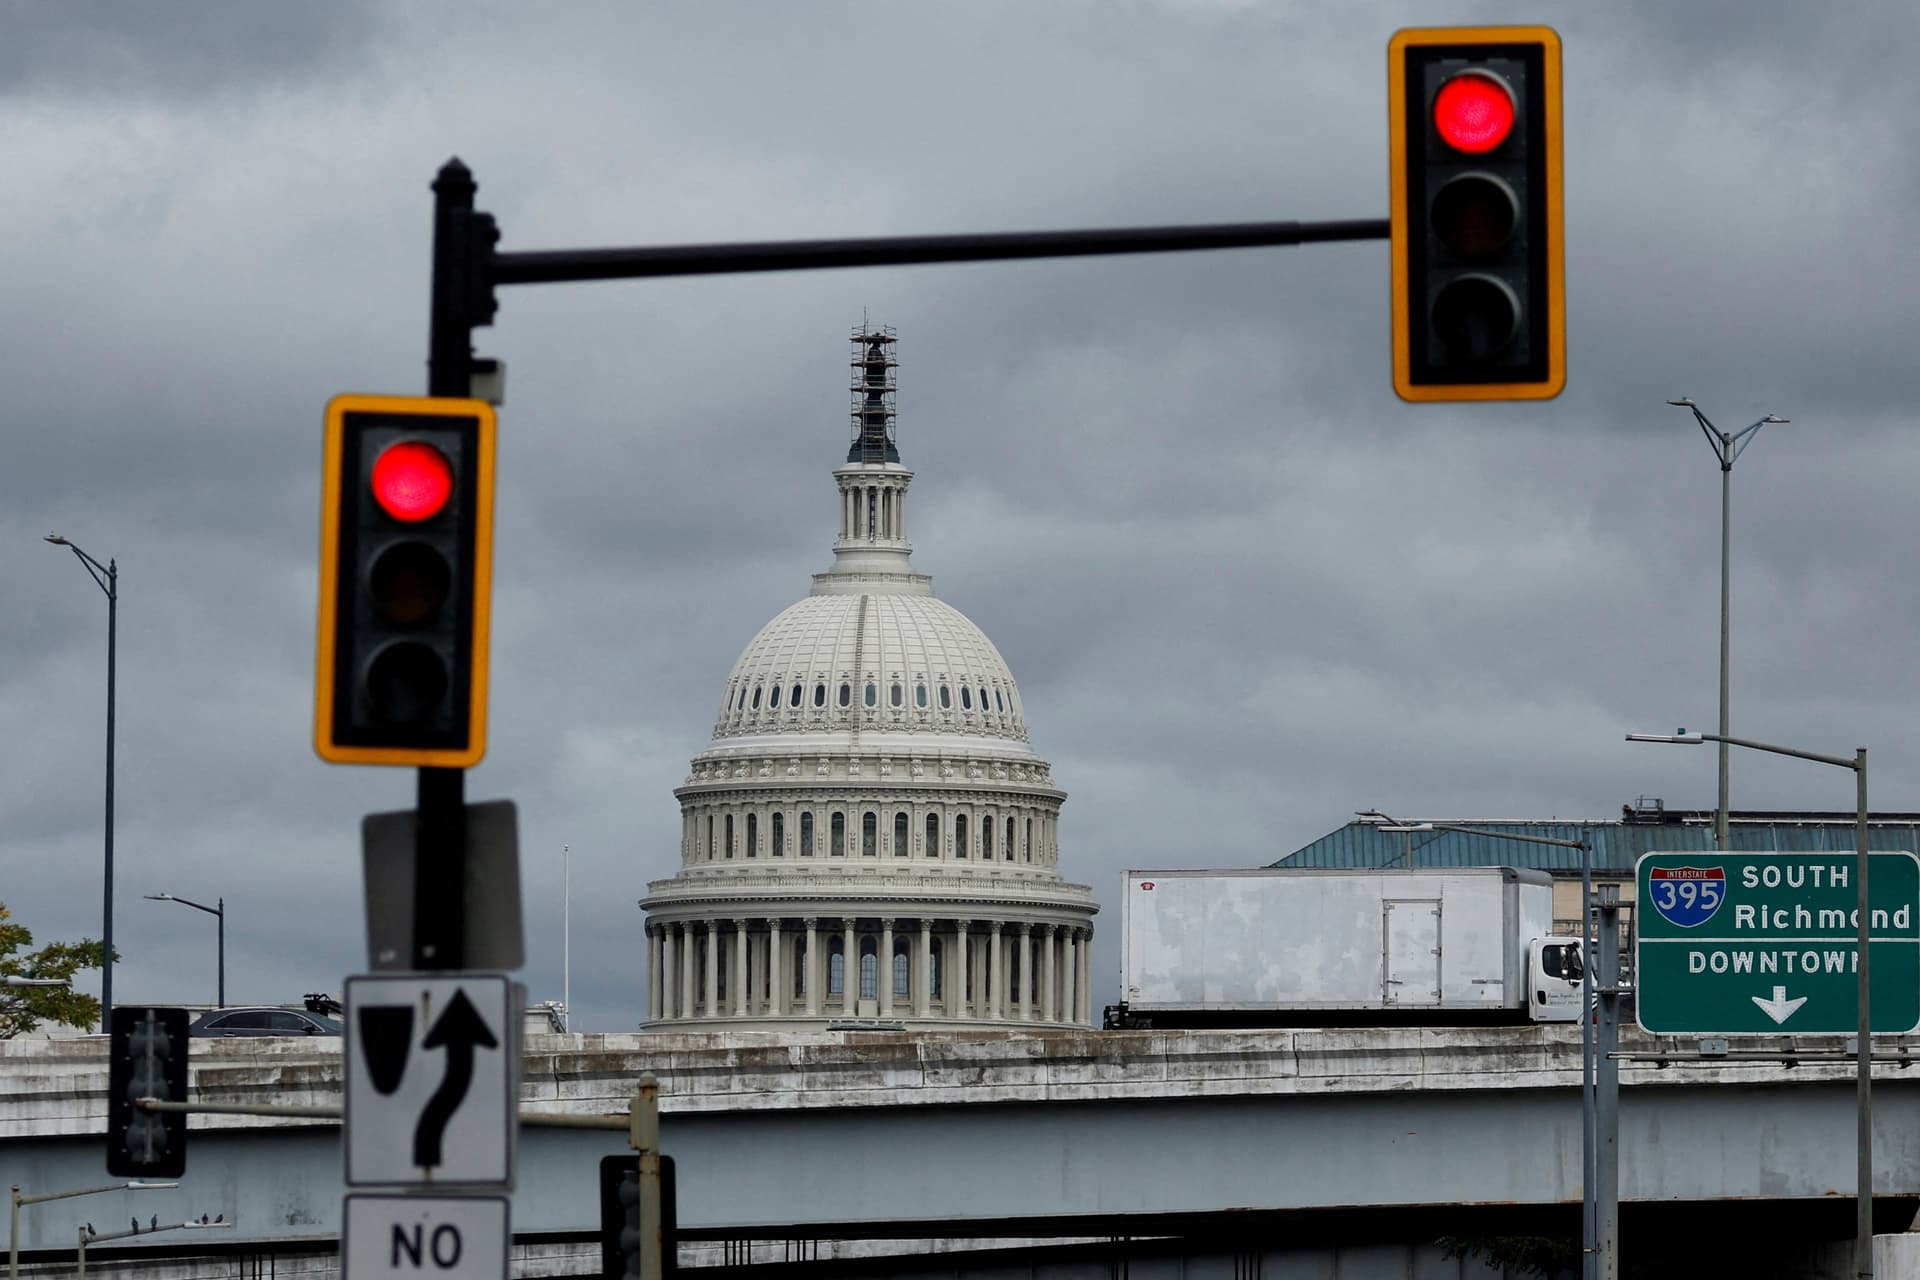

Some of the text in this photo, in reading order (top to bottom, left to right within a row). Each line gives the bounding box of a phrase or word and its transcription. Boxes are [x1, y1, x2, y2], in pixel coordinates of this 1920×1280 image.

[1666, 870, 1708, 879] INTERSTATE
[1742, 865, 1848, 888] SOUTH
[1658, 881, 1719, 910] 395
[390, 1222, 463, 1270] NO
